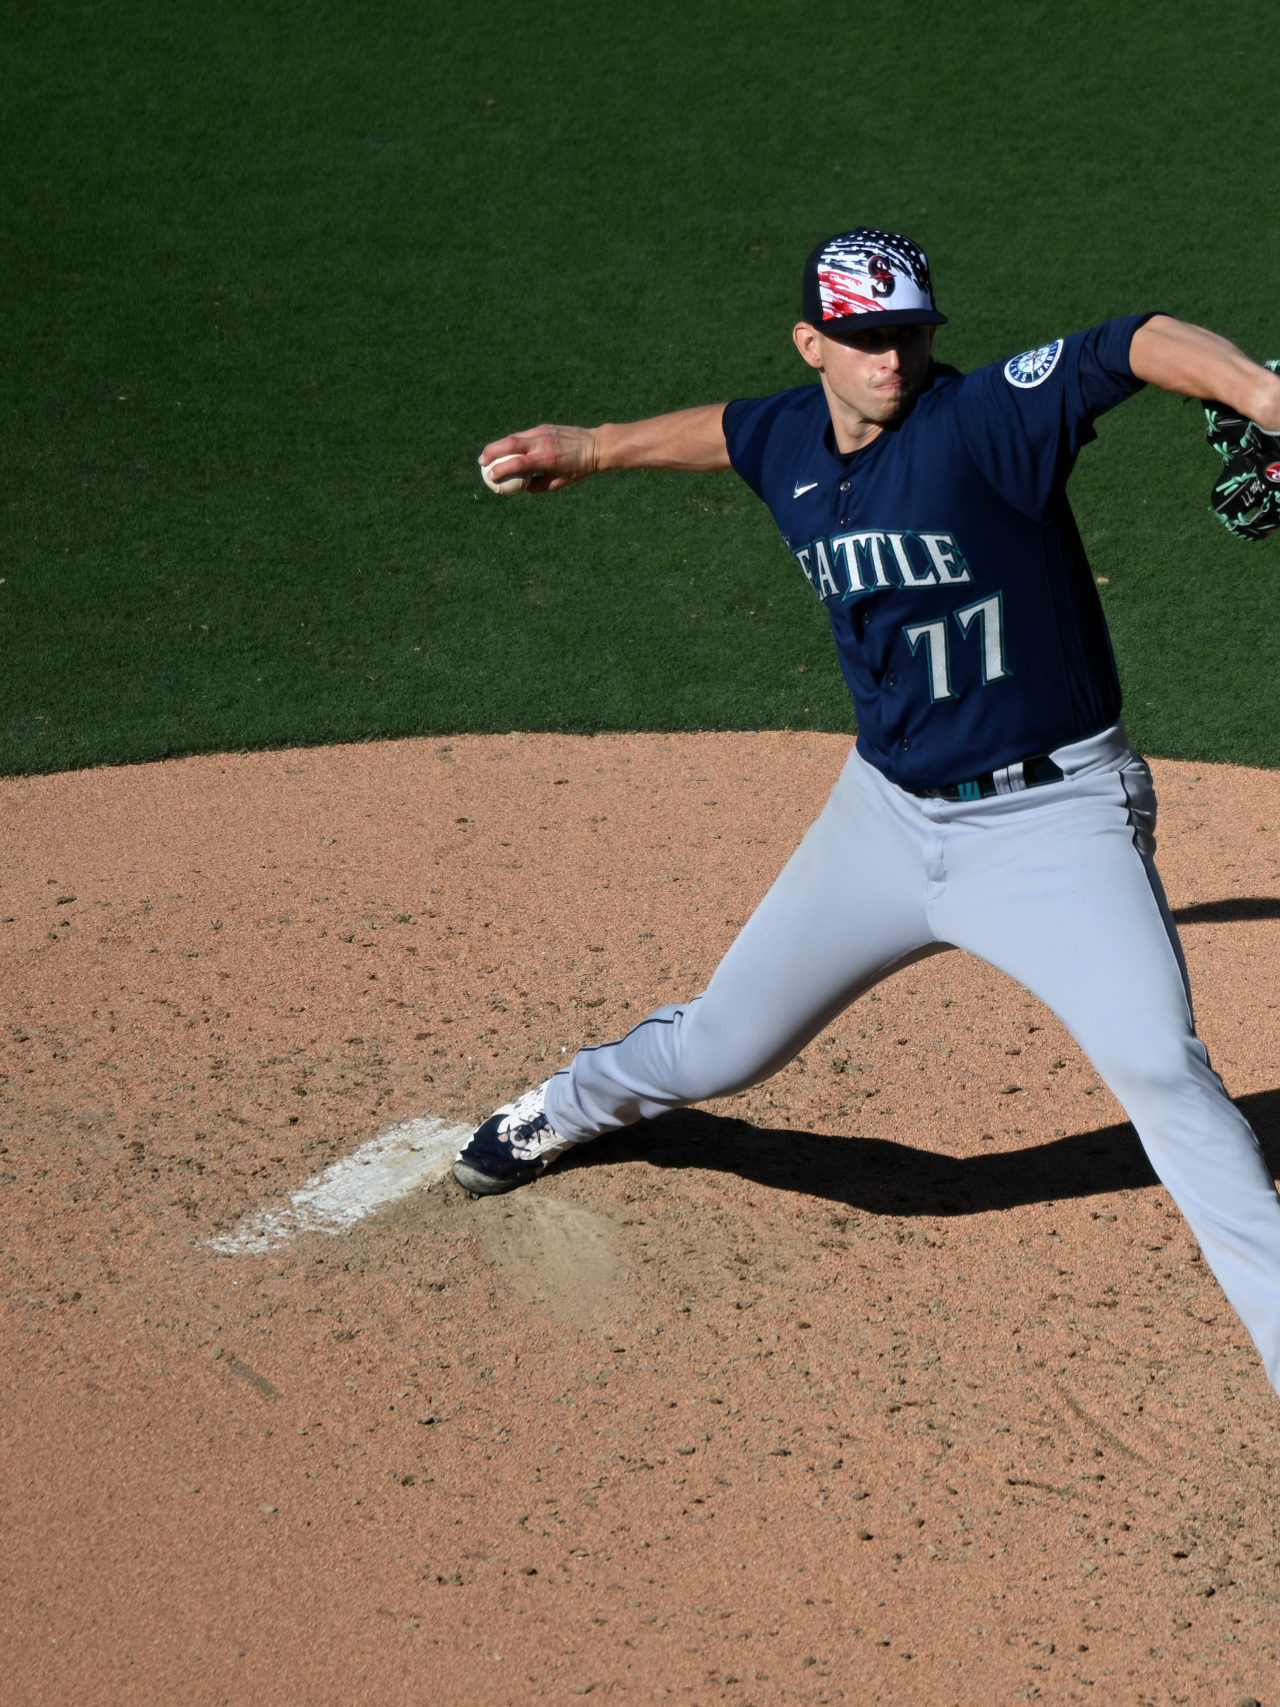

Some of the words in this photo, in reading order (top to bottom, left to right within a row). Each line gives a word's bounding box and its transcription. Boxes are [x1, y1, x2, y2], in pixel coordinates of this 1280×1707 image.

[868, 255, 897, 299] S
[786, 529, 976, 602] EATTLE
[902, 589, 1014, 705] 77
